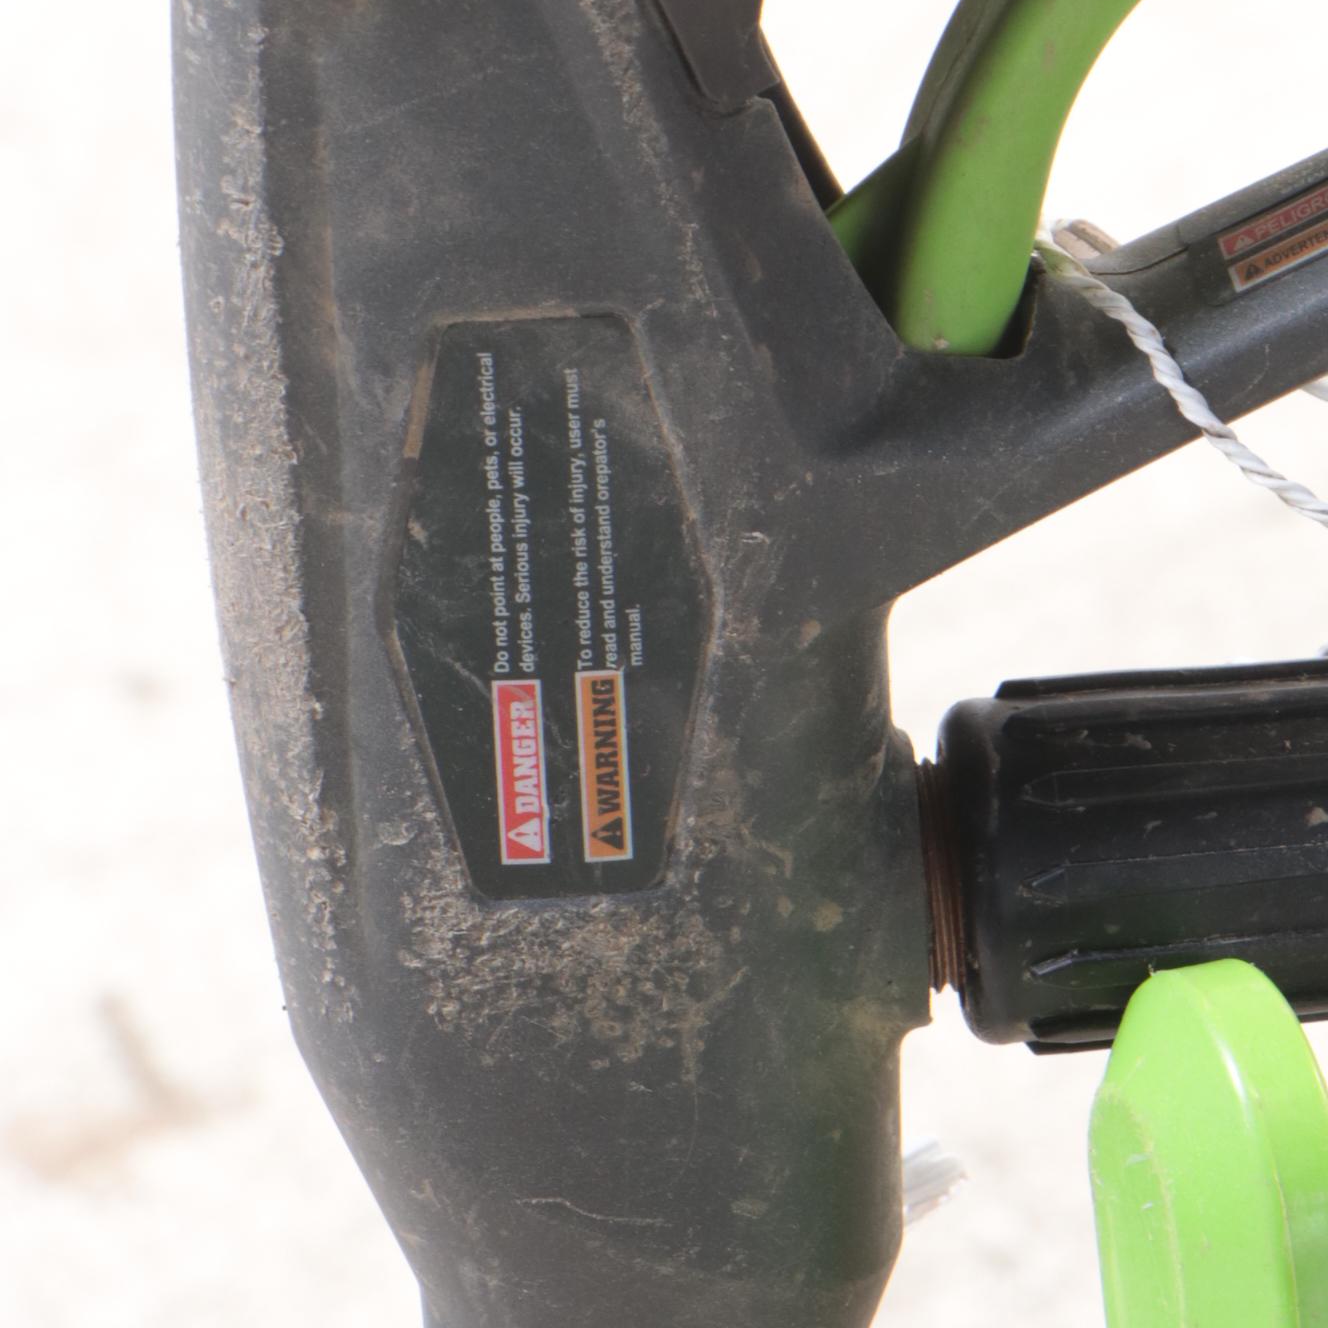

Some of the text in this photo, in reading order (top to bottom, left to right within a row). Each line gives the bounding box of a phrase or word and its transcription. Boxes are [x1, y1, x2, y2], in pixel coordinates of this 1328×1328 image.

[477, 352, 510, 673] Do not point at people, pets, or electrical
[508, 406, 535, 672] devices. Serious injury will occur.
[564, 368, 593, 670] To reduce the risk of injury, user must
[591, 418, 617, 670] read and understand orepator's
[625, 603, 643, 666] manual.
[510, 700, 539, 814] DANGER
[591, 678, 621, 815] WARNING
